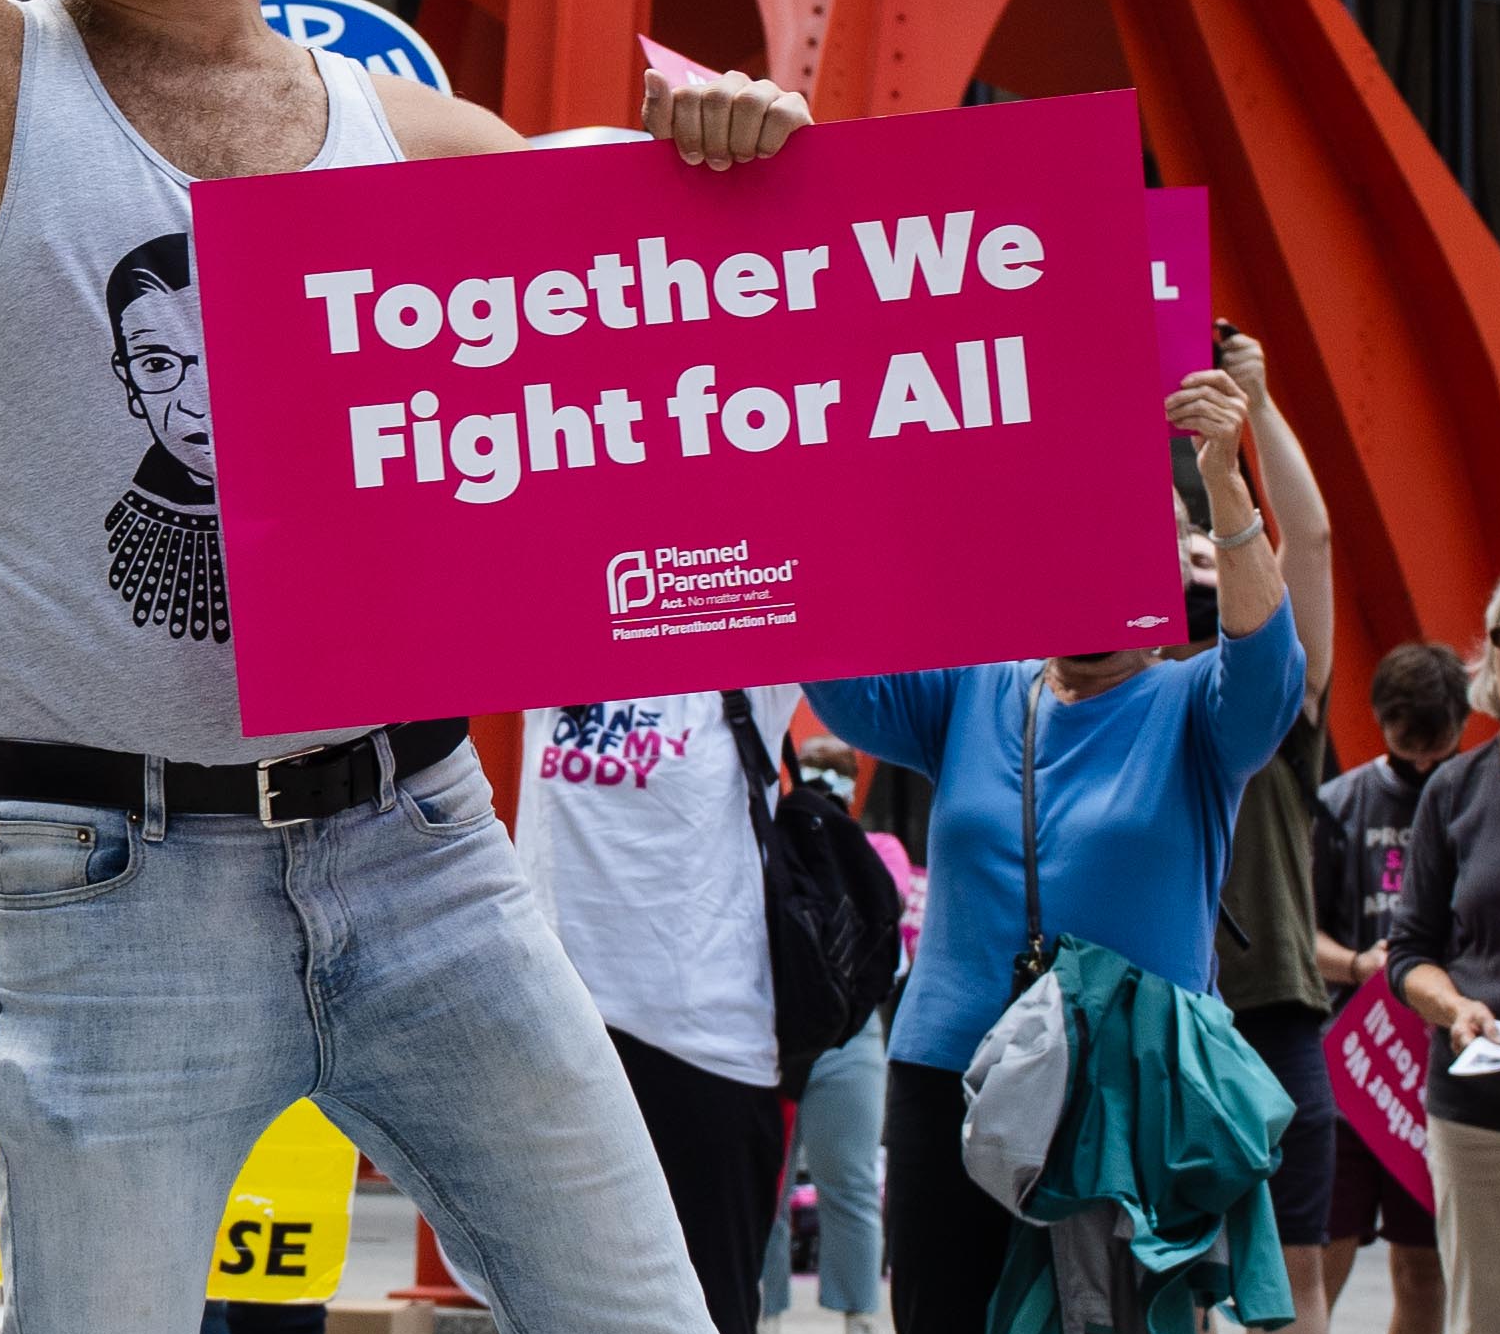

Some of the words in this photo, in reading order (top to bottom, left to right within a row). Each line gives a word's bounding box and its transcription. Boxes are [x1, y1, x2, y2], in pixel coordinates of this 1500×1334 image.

[304, 236, 828, 369] Together
[852, 210, 1045, 301] We
[348, 380, 645, 505] Fight
[667, 364, 841, 459] for
[868, 337, 1032, 439] All
[655, 540, 748, 569] Planned
[658, 560, 795, 593] Parenthood
[660, 598, 686, 610] Act.
[688, 596, 704, 607] No
[706, 593, 741, 605] matter
[743, 588, 774, 602] what.
[612, 626, 660, 641] Planned
[661, 620, 726, 636] Parenthood
[728, 615, 765, 629] Action
[767, 610, 797, 625] Fund
[540, 745, 660, 789] BODY
[1366, 1074, 1432, 1160] ether
[219, 1220, 313, 1278] SE
